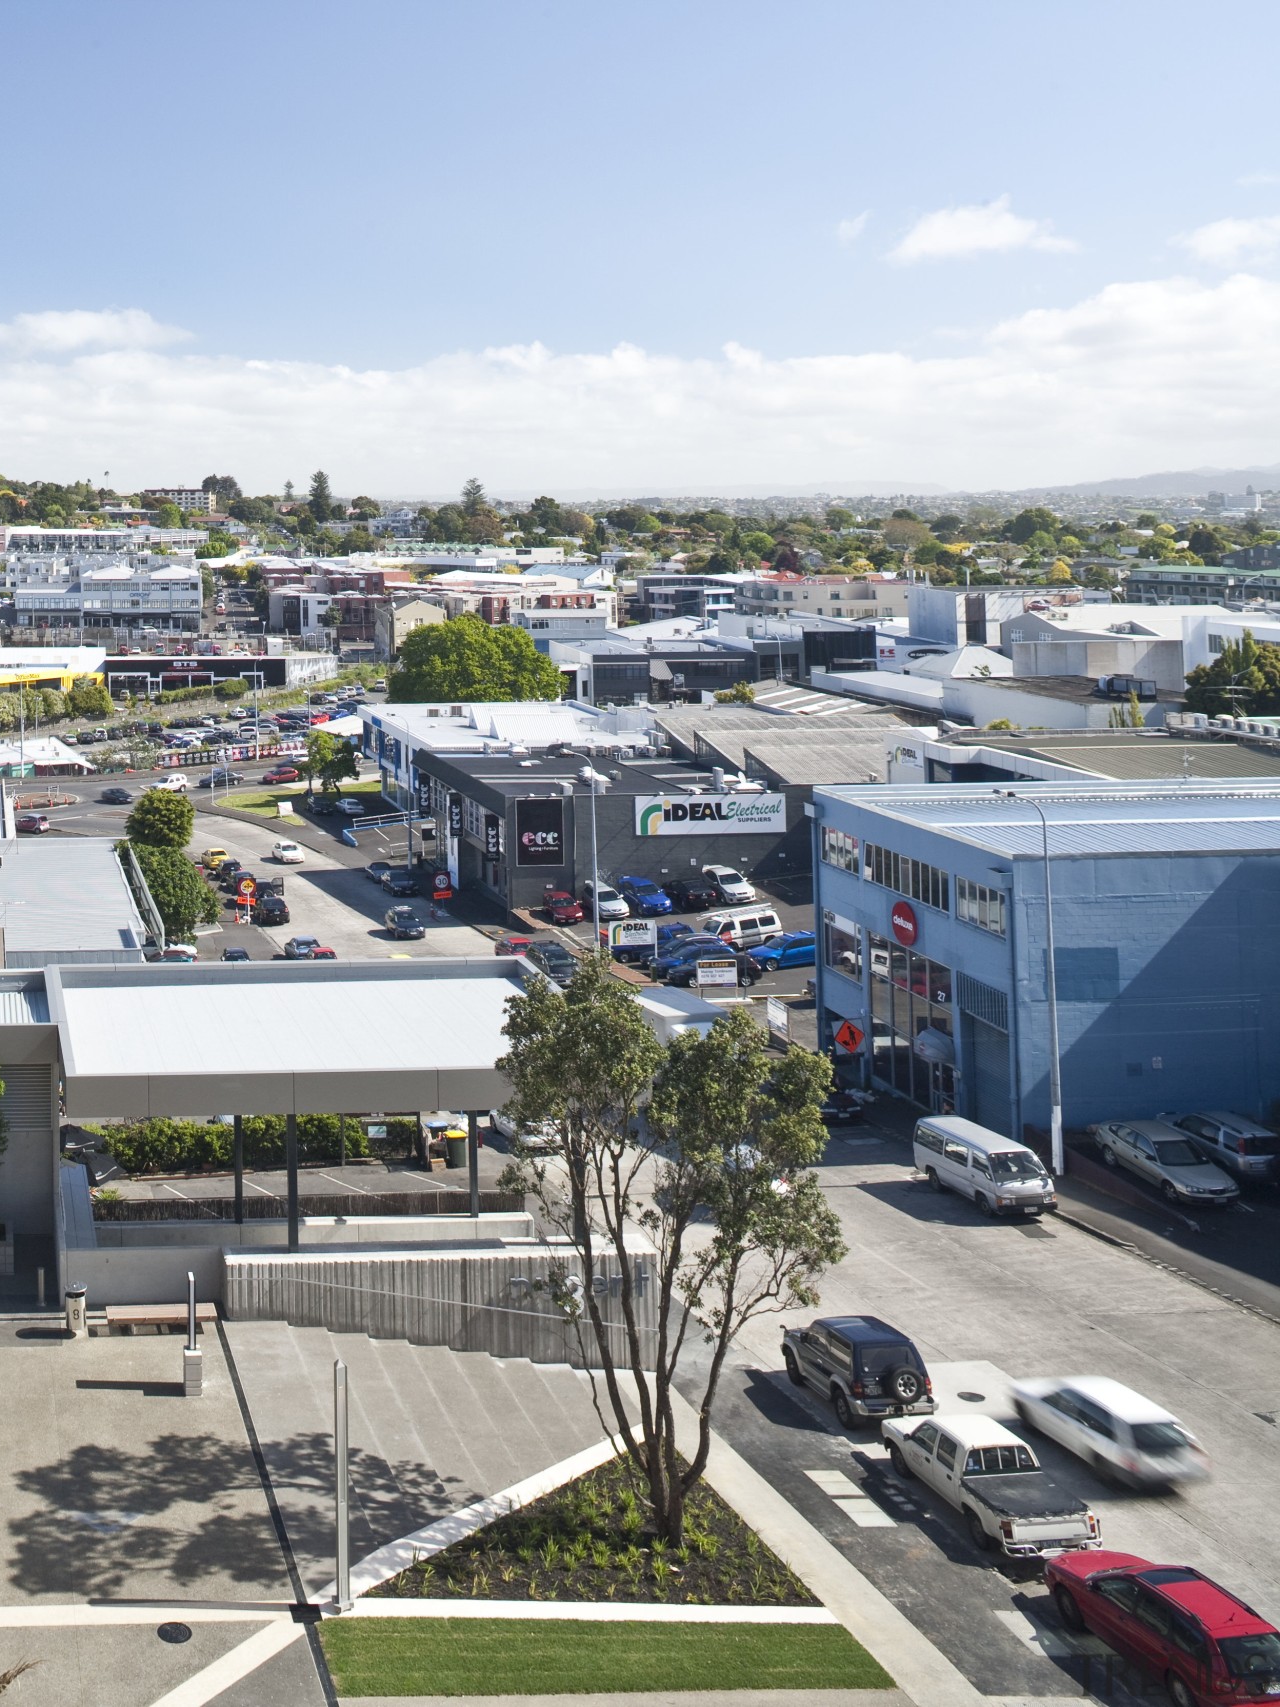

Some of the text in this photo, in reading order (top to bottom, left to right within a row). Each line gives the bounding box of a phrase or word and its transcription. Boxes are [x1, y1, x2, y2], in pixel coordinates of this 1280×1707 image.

[726, 799, 782, 820] Electrical
[436, 878, 448, 886] 30
[892, 914, 913, 931] deluxe
[938, 990, 946, 1002] 27
